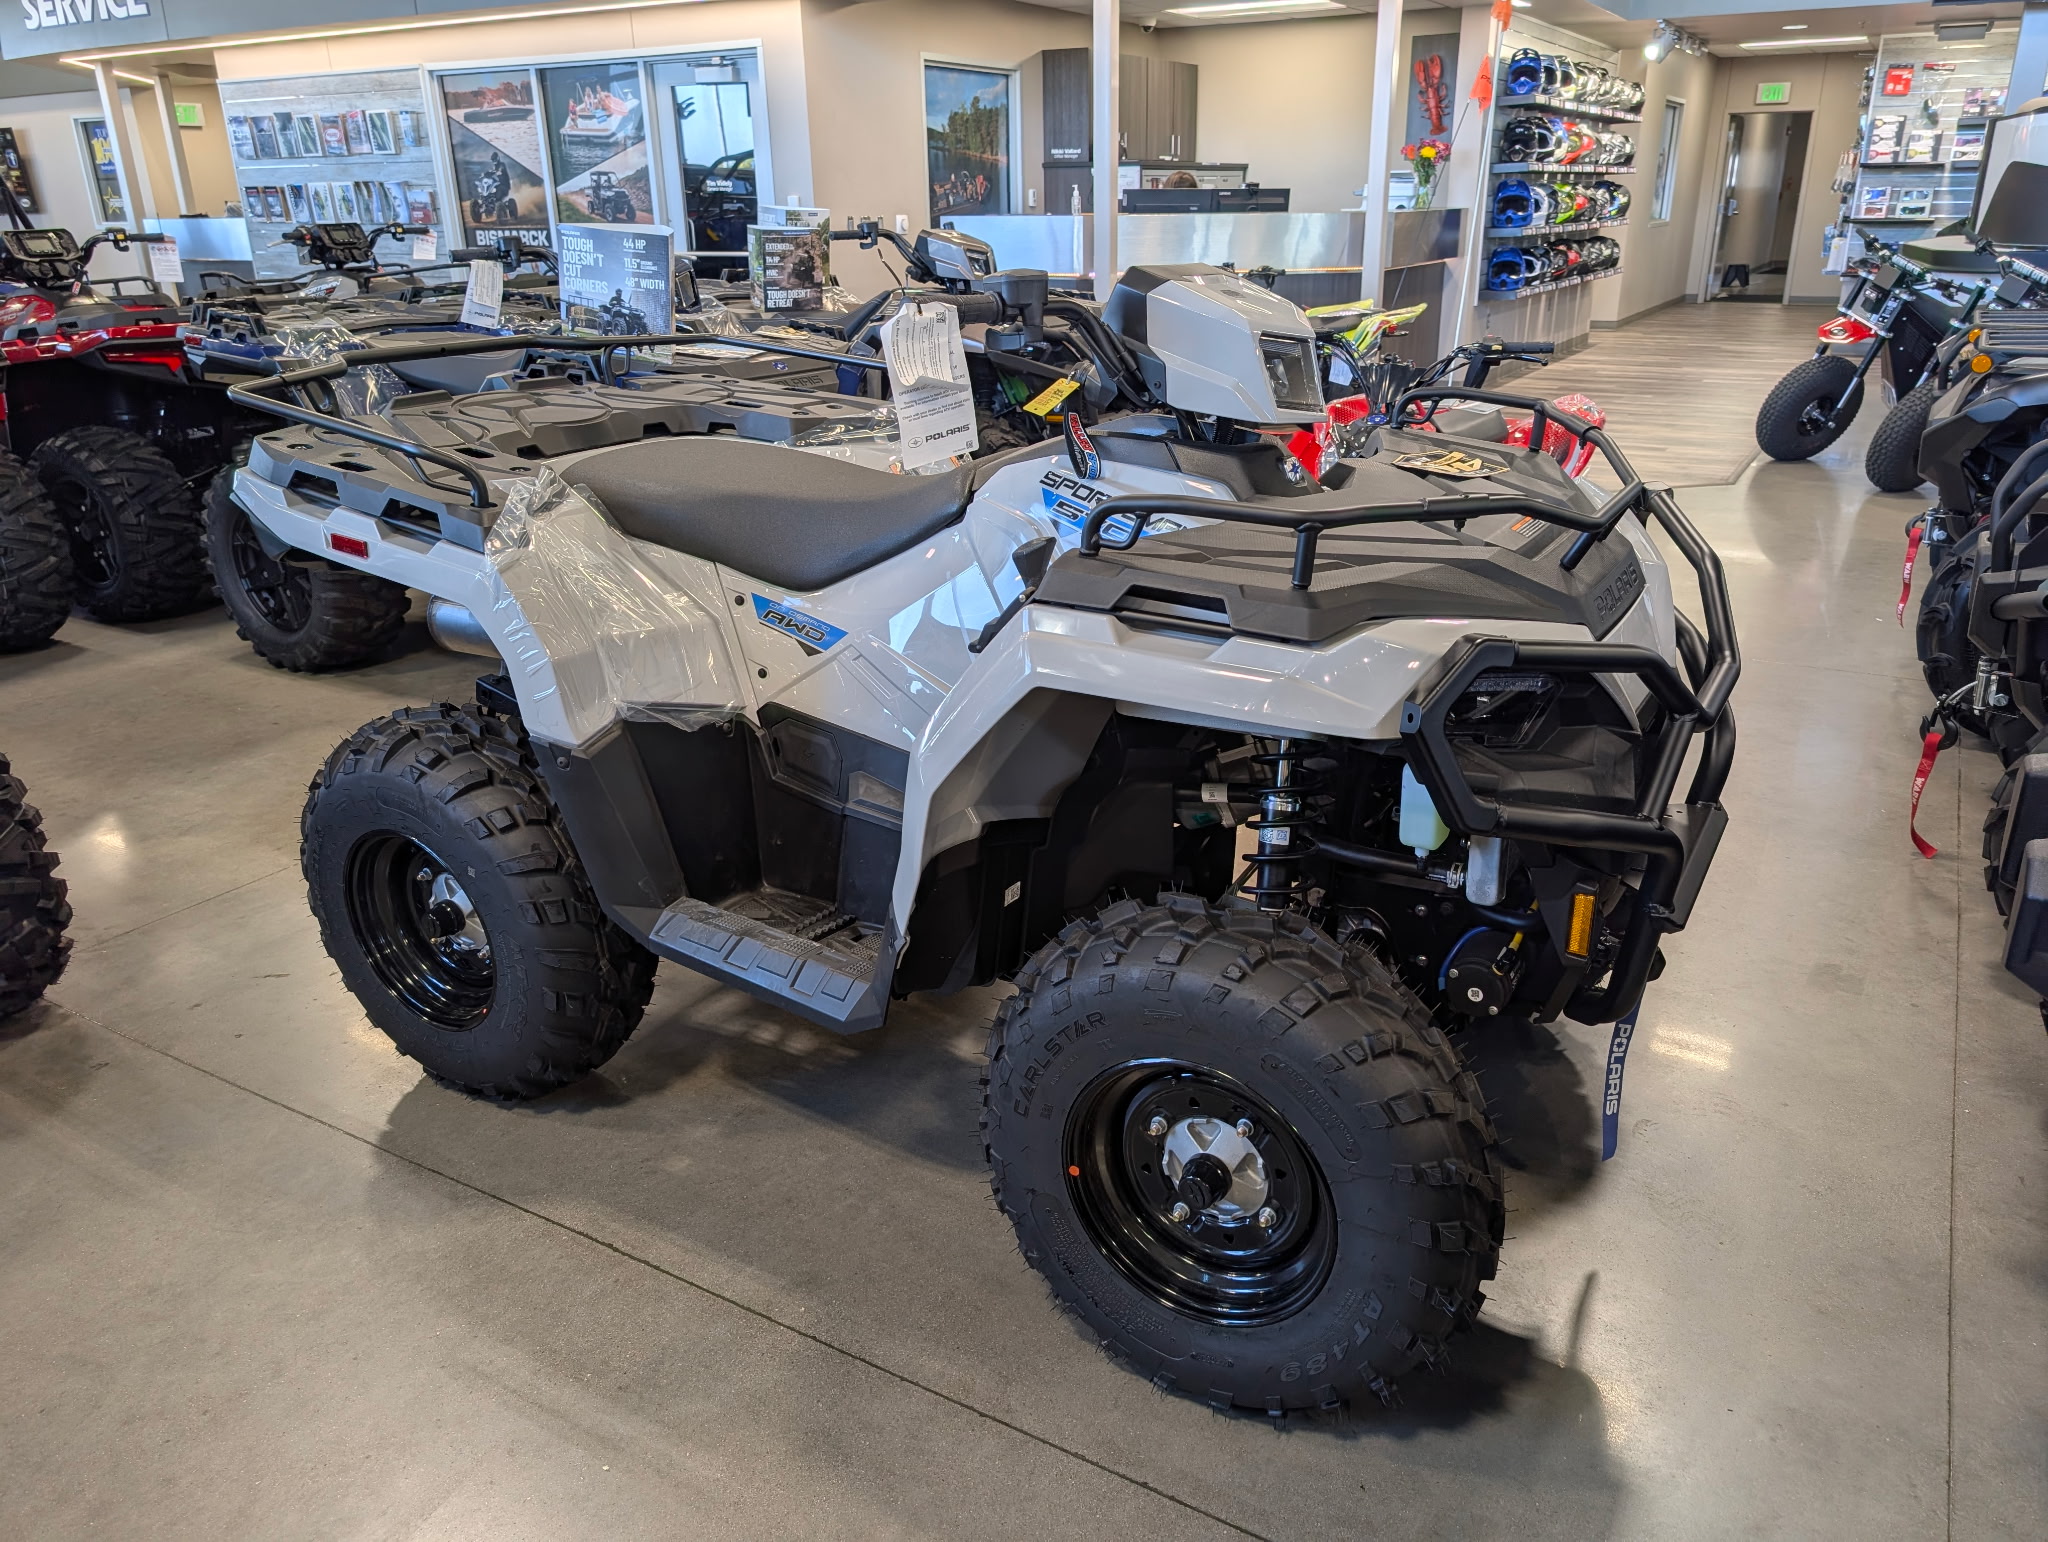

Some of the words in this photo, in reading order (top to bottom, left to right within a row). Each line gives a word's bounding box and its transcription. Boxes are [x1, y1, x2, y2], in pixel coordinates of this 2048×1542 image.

[23, 0, 150, 30] SERVICE
[1761, 85, 1785, 101] EXIT
[562, 236, 593, 252] TOUGH
[623, 238, 634, 249] 44
[635, 239, 647, 250] HP
[563, 249, 604, 267] DOESN'T
[564, 264, 582, 278] CUT
[564, 277, 608, 294] CORNERS
[639, 278, 665, 290] WIDTH
[767, 290, 788, 299] TOUGH
[788, 289, 810, 299] DOESN'T
[767, 299, 794, 308] RETREAT
[926, 423, 970, 443] POLARIS
[1594, 562, 1638, 616] POLARIS
[762, 609, 826, 642] AWD
[1013, 1010, 1107, 1119] CARLSTAR
[1606, 1023, 1632, 1116] POLARIS
